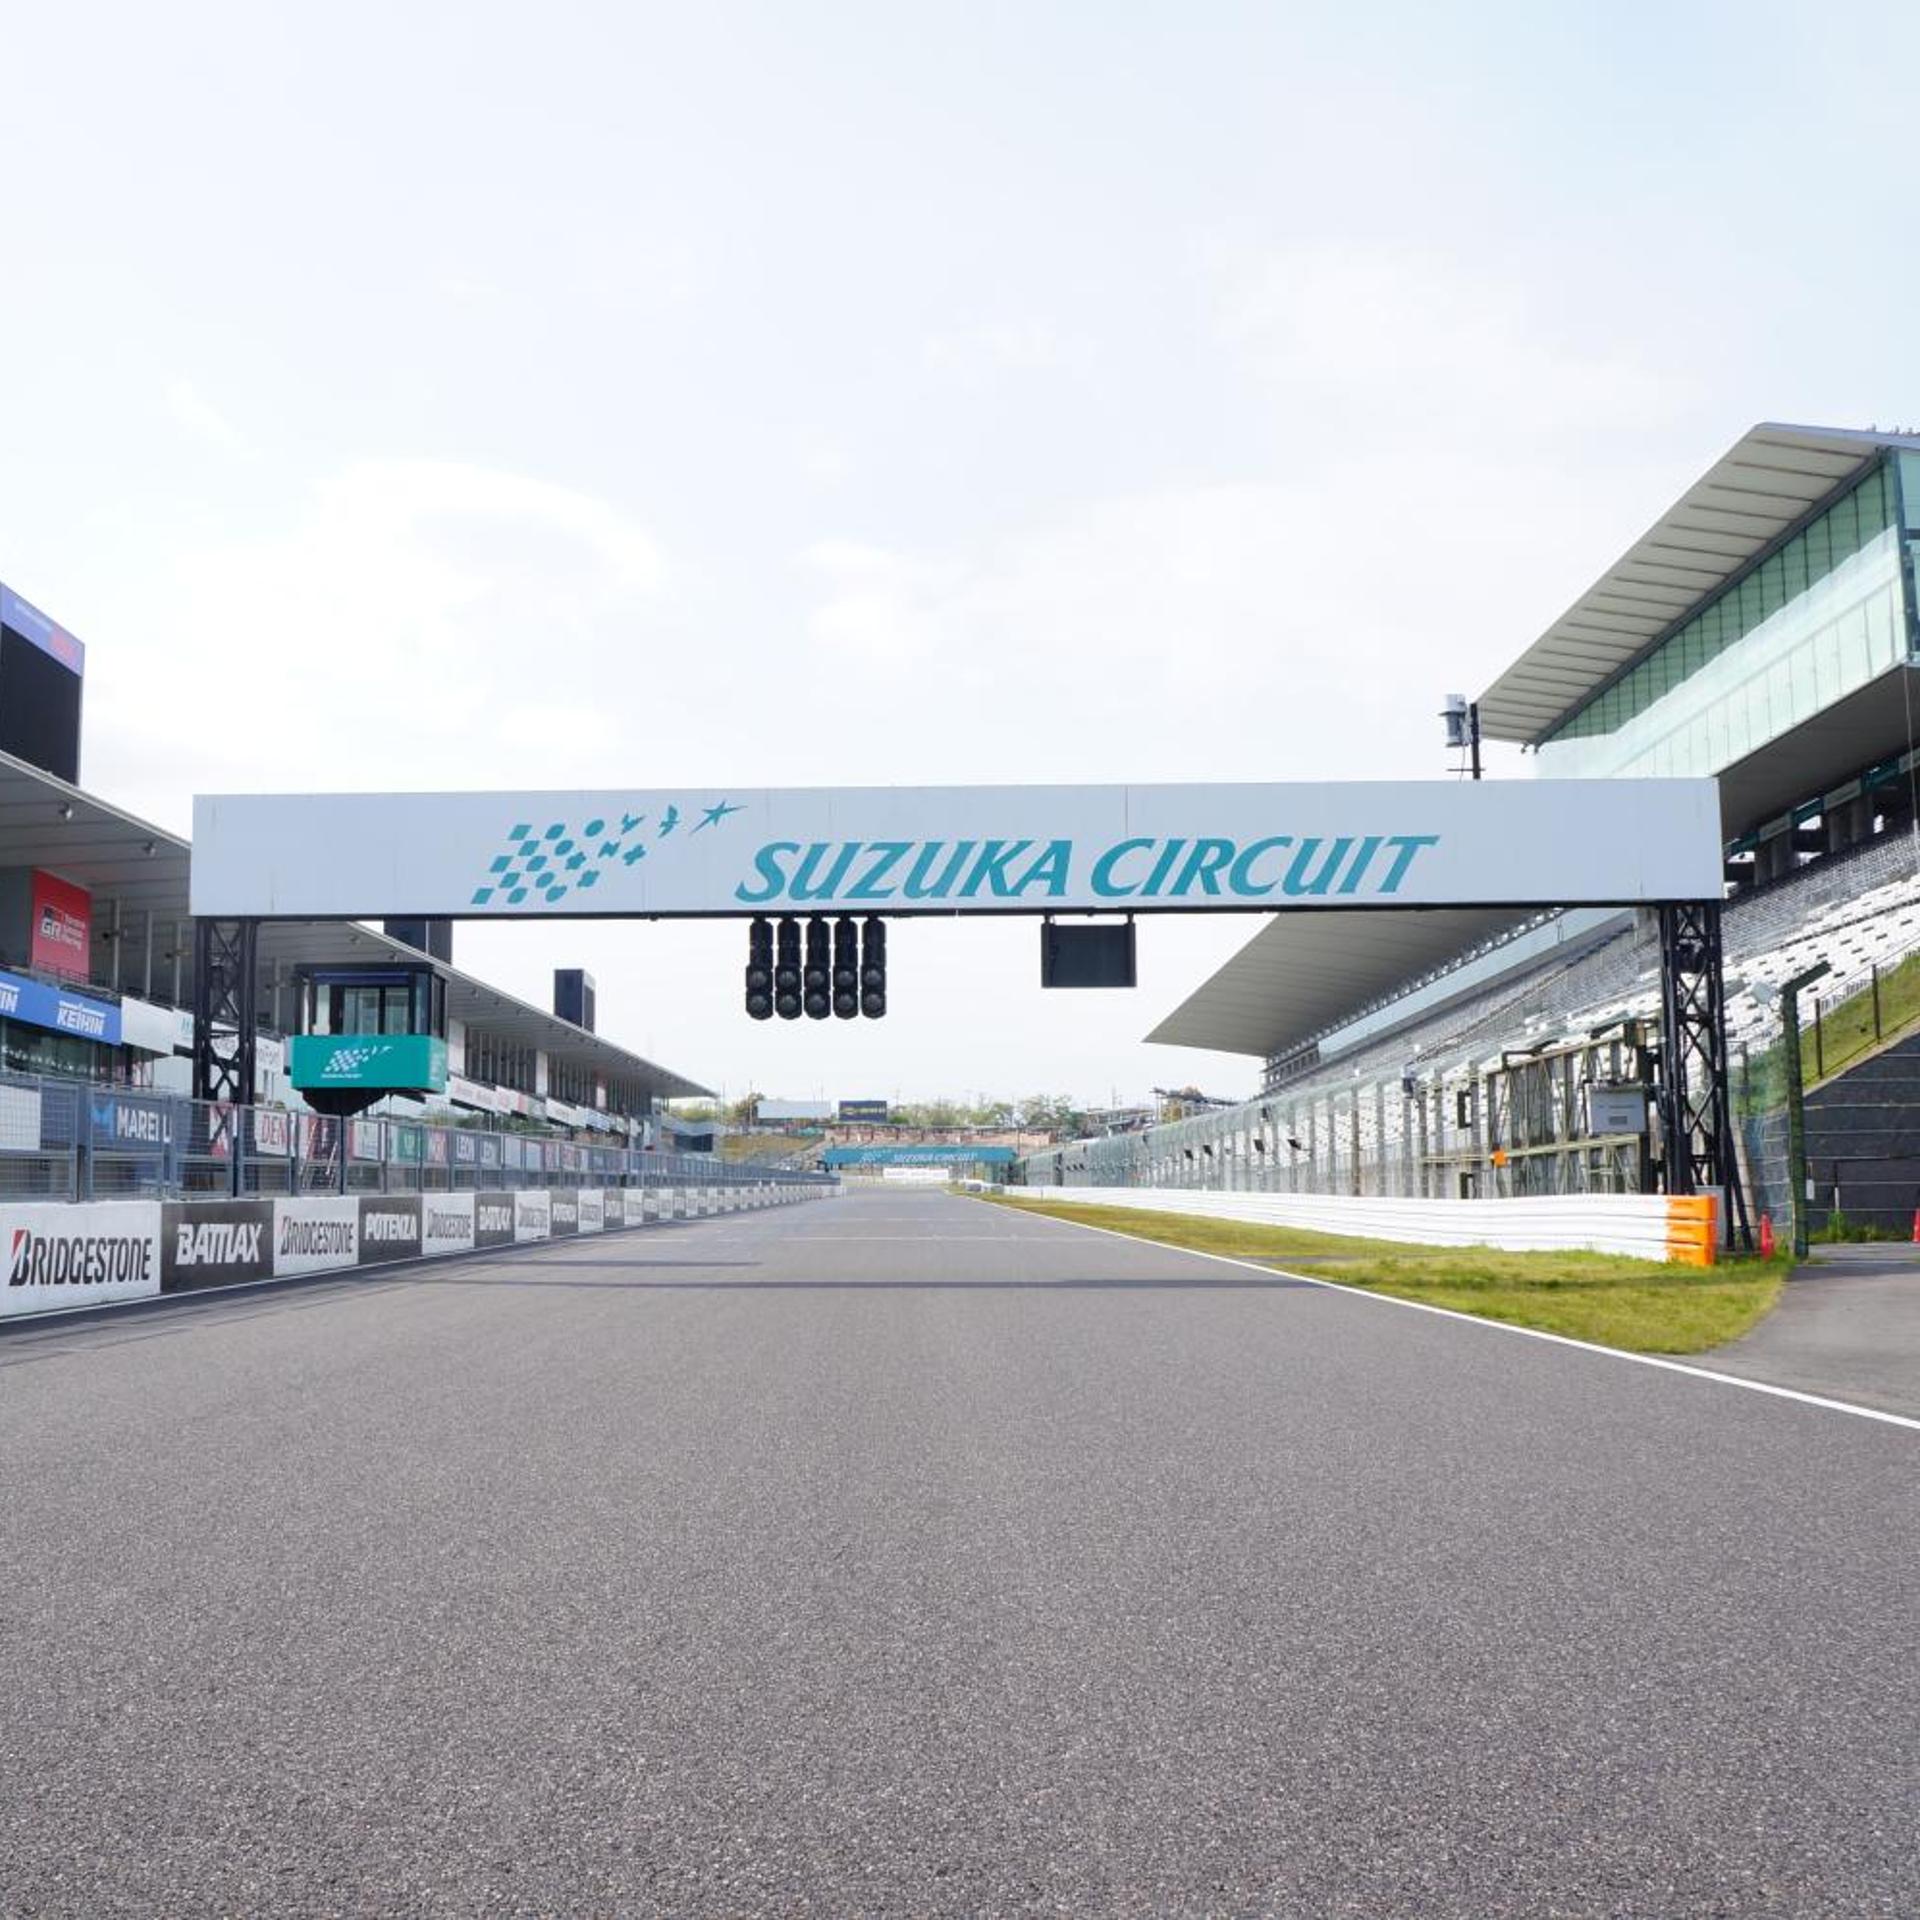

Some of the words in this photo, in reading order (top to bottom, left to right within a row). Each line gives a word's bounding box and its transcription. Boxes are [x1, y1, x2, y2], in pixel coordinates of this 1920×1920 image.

[734, 838, 1074, 905] SUZUKA
[1087, 834, 1440, 899] CIRCUIT
[57, 1000, 106, 1036] KEIHIN
[175, 1223, 263, 1266] BATTLAX
[280, 1215, 354, 1256] BRIDGESTONE
[365, 1213, 418, 1241] POTENZA
[9, 1228, 152, 1287] BRIDGESTONE
